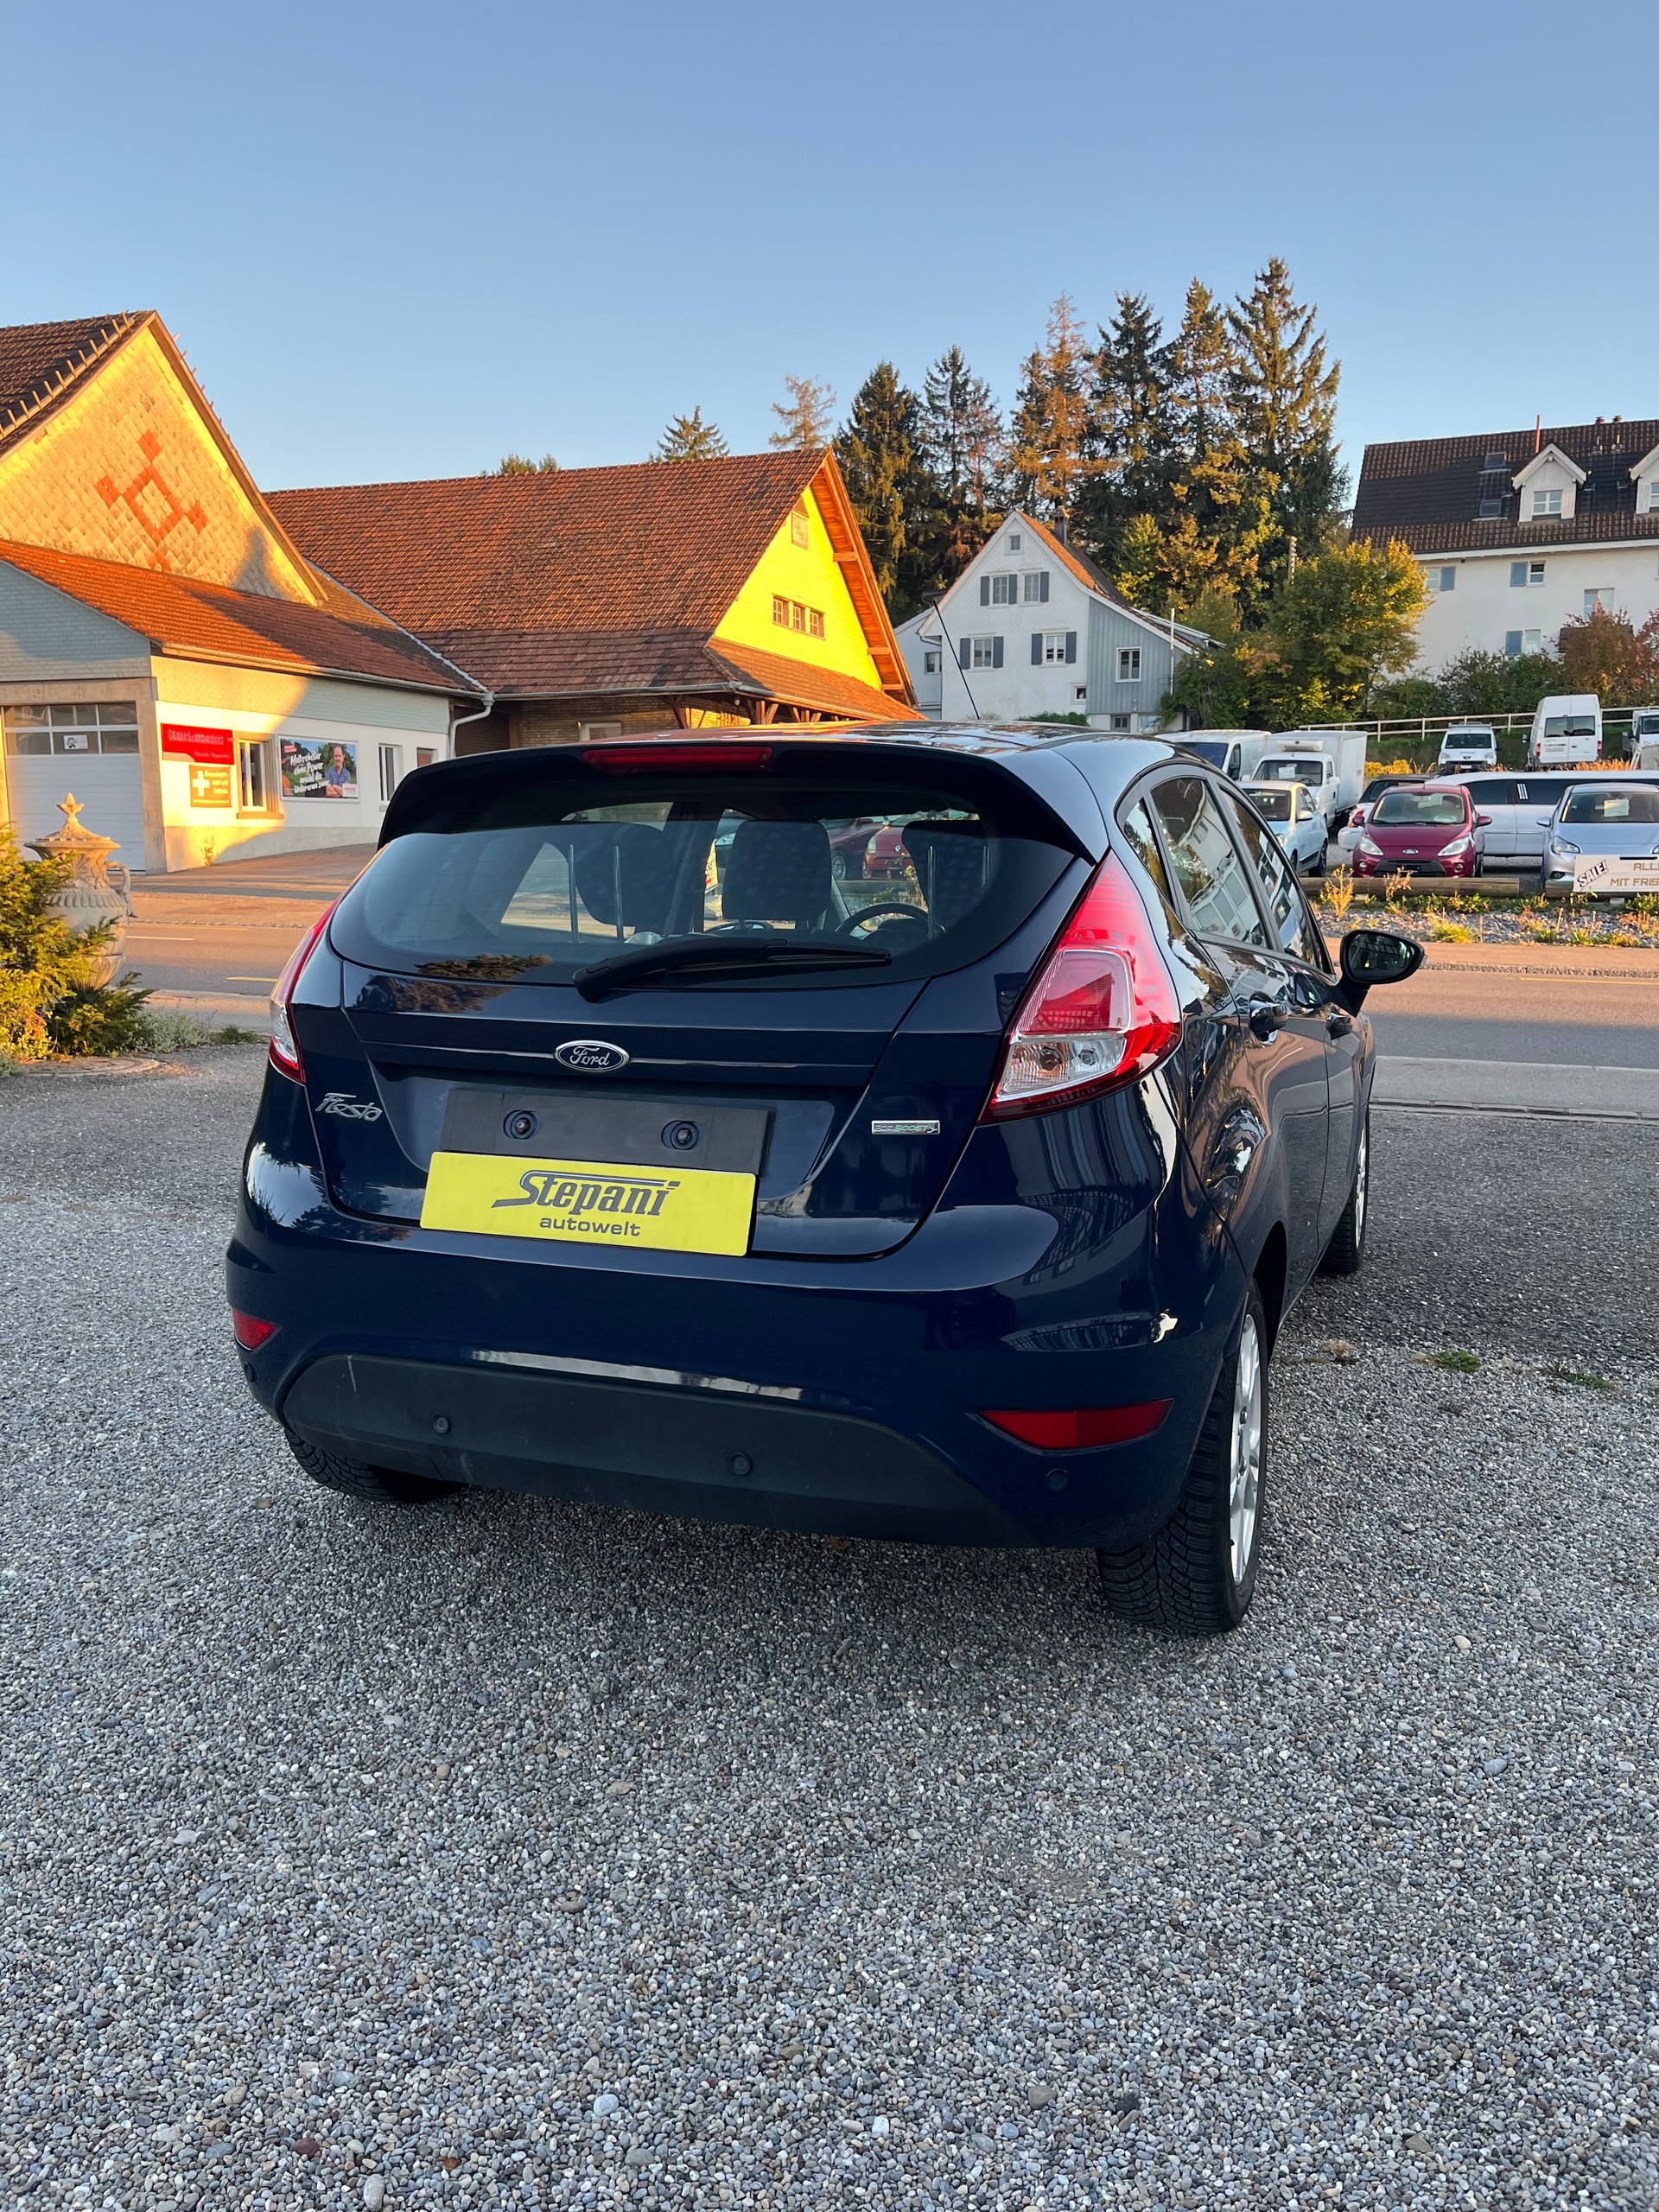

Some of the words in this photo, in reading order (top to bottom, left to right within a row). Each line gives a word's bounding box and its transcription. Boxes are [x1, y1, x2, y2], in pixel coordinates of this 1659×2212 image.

[1577, 859, 1609, 887] SALE!
[1633, 862, 1659, 871] ALL
[1610, 878, 1630, 887] MIT
[569, 1046, 611, 1066] Ford
[315, 1092, 383, 1122] Fiesta
[491, 1169, 681, 1217] Stepani
[539, 1217, 641, 1237] autowelt
